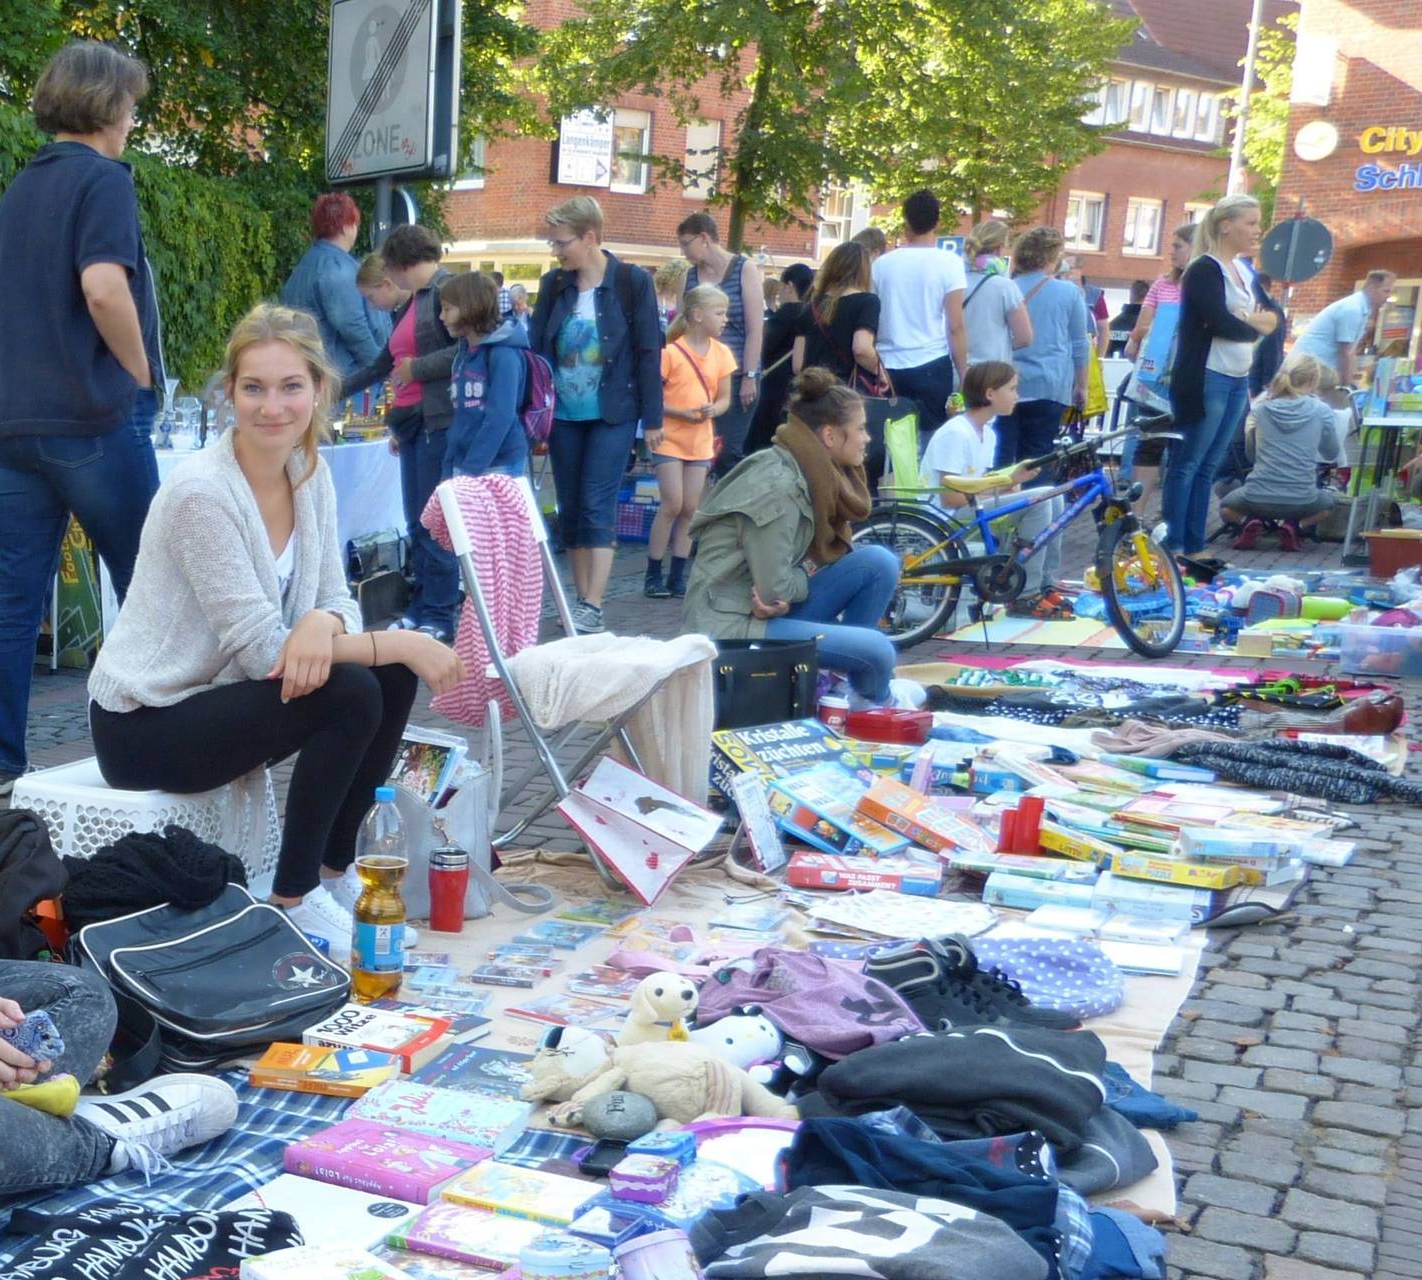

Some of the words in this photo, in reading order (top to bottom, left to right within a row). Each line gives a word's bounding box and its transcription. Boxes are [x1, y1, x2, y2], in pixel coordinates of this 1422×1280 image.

[737, 722, 811, 746] Kristalle
[756, 739, 827, 763] züchten
[316, 1009, 361, 1035] 1000
[334, 1014, 378, 1037] Witze
